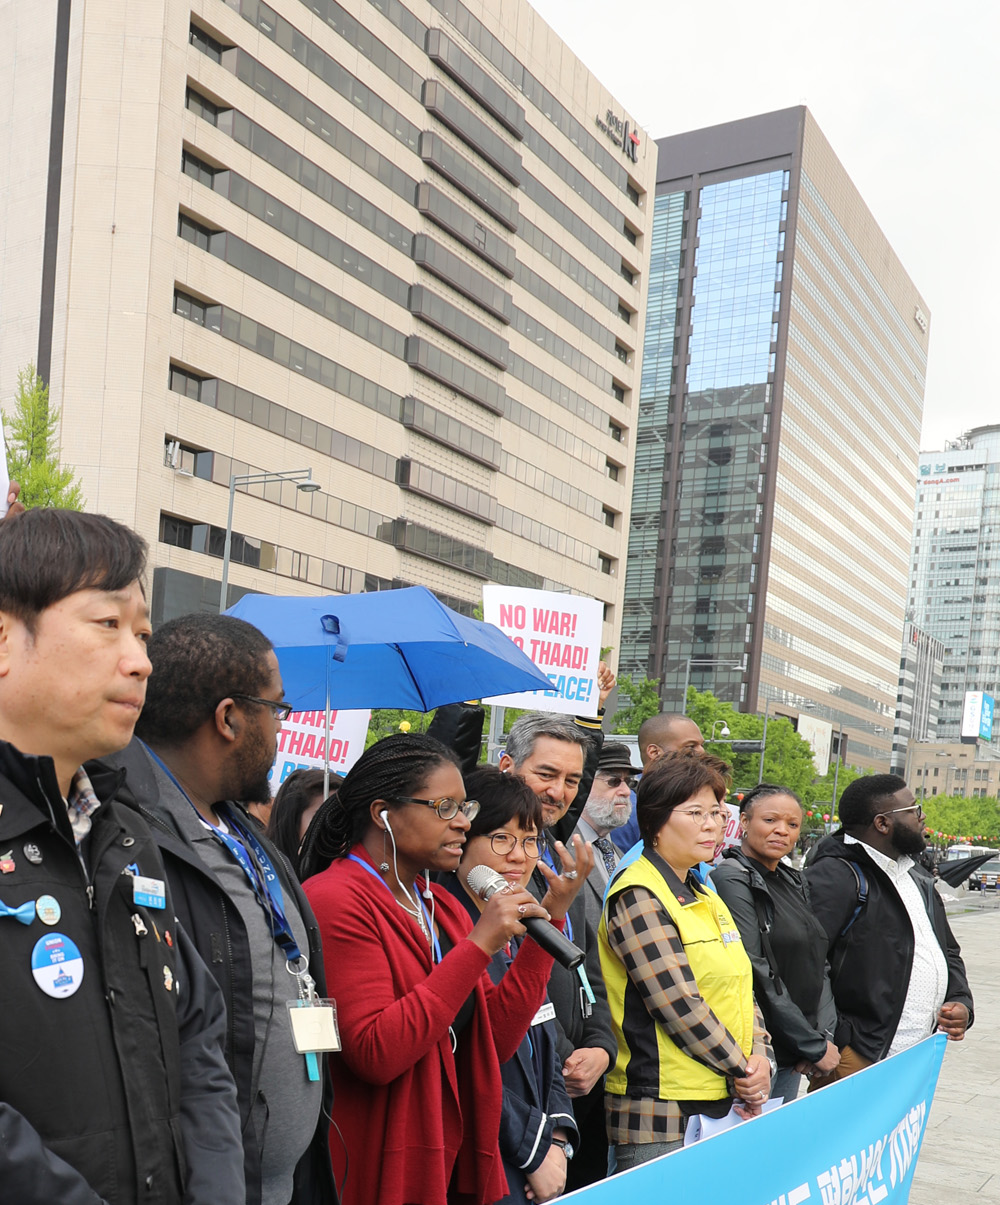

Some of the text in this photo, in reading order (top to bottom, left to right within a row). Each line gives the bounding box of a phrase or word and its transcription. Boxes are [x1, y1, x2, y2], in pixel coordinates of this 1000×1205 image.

[622, 120, 640, 163] kt
[500, 604, 577, 638] NO WAR!
[530, 639, 589, 671] THAAD!
[278, 729, 349, 764] THAAD!
